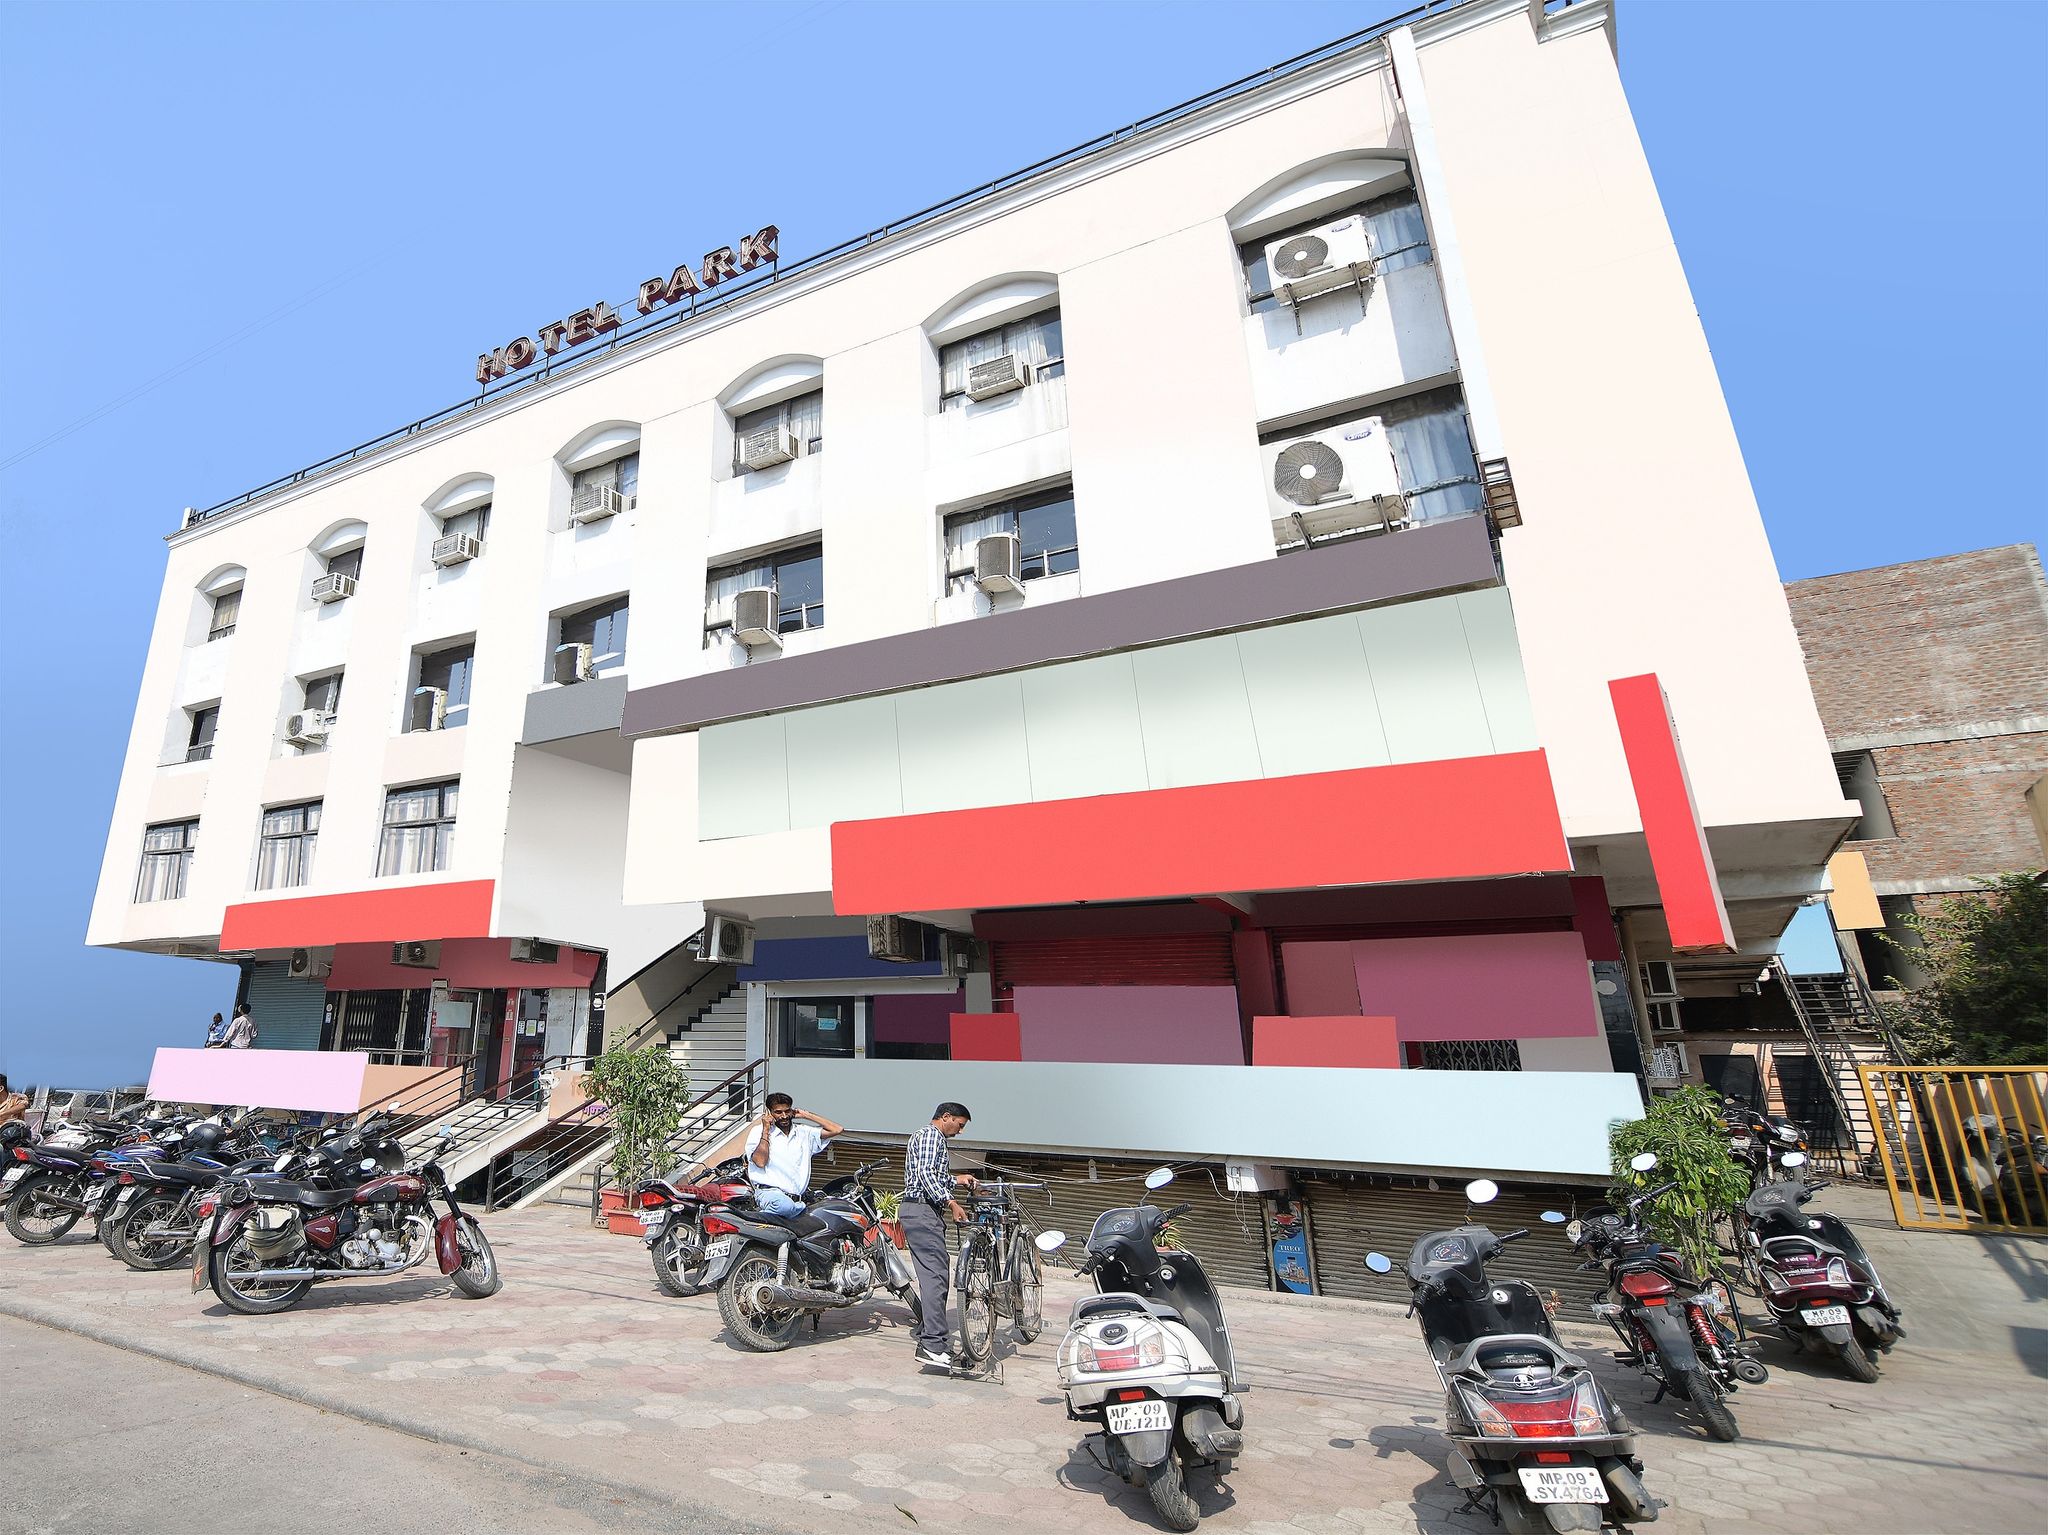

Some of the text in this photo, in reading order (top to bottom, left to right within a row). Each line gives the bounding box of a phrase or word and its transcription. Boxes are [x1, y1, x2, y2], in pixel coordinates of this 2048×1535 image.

[476, 225, 780, 384] HOTEL PARK
[1279, 1244, 1301, 1252] TREO
[1811, 1307, 1842, 1318] MP 09
